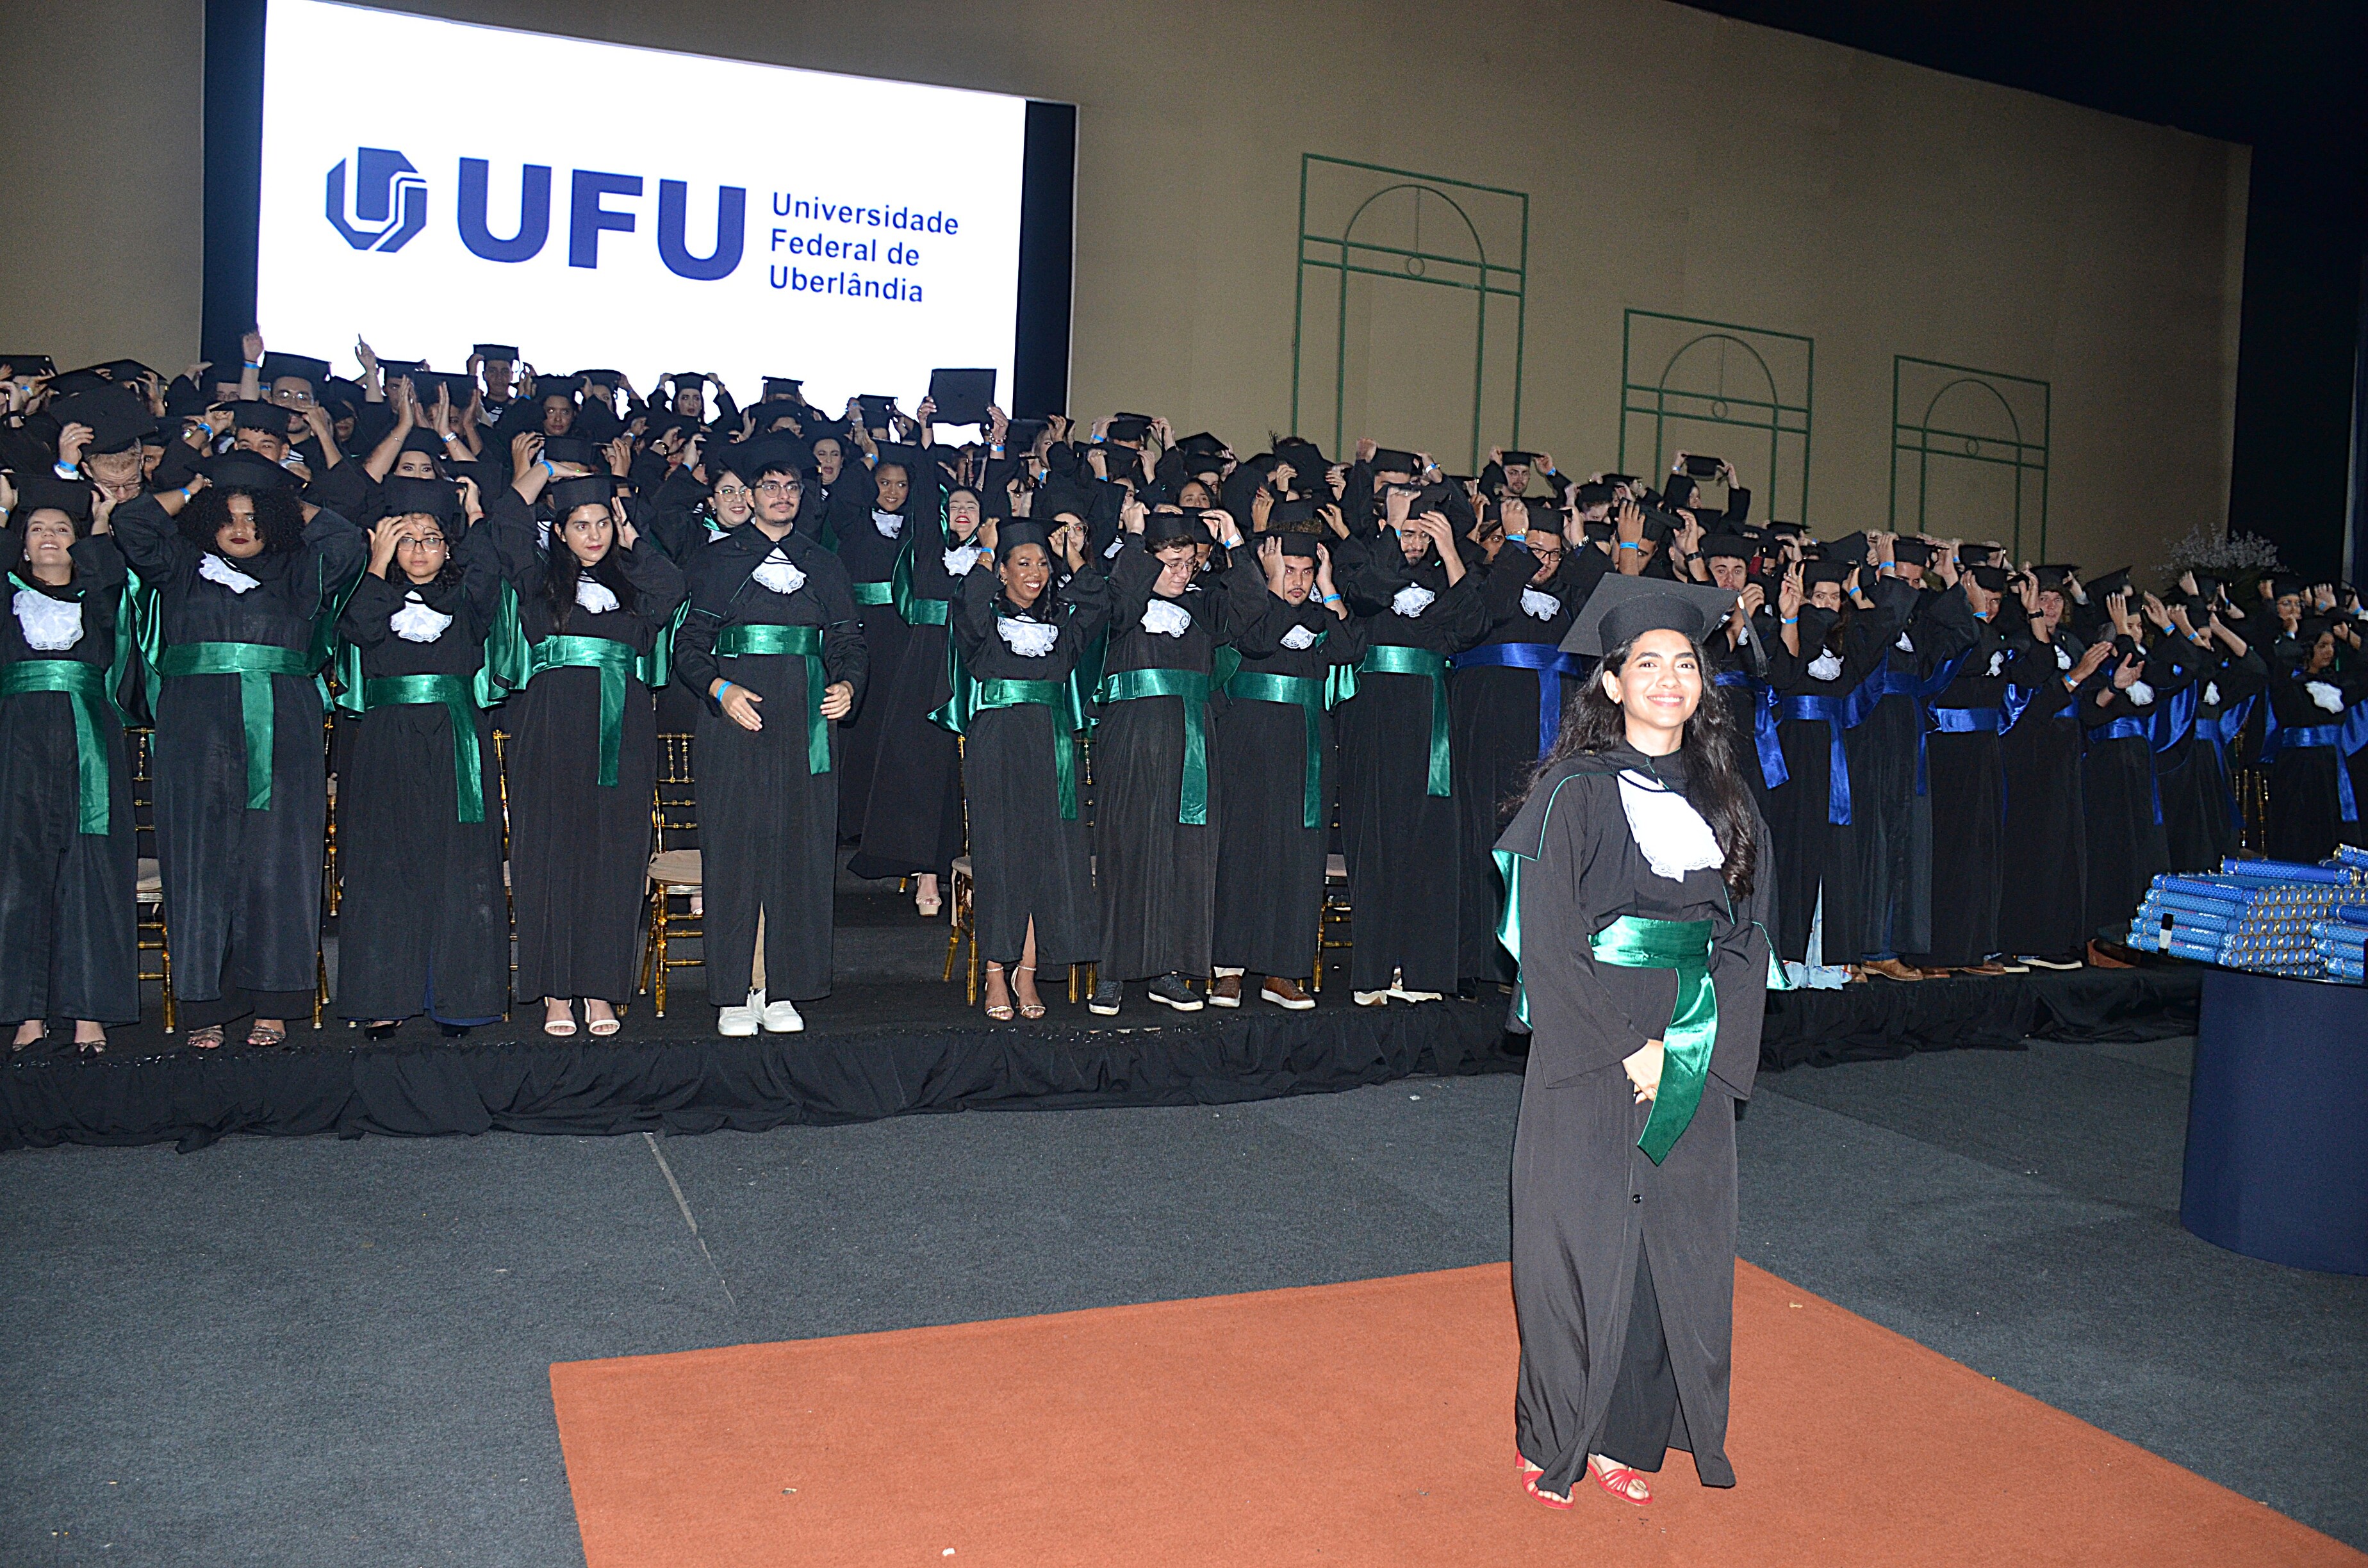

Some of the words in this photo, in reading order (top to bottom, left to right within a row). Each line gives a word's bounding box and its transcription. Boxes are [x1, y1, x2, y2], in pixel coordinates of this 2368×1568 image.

[456, 156, 747, 282] UFU
[772, 191, 959, 236] Universidade
[771, 227, 877, 263] Federal
[887, 241, 920, 267] de
[769, 264, 923, 303] Uberlândia
